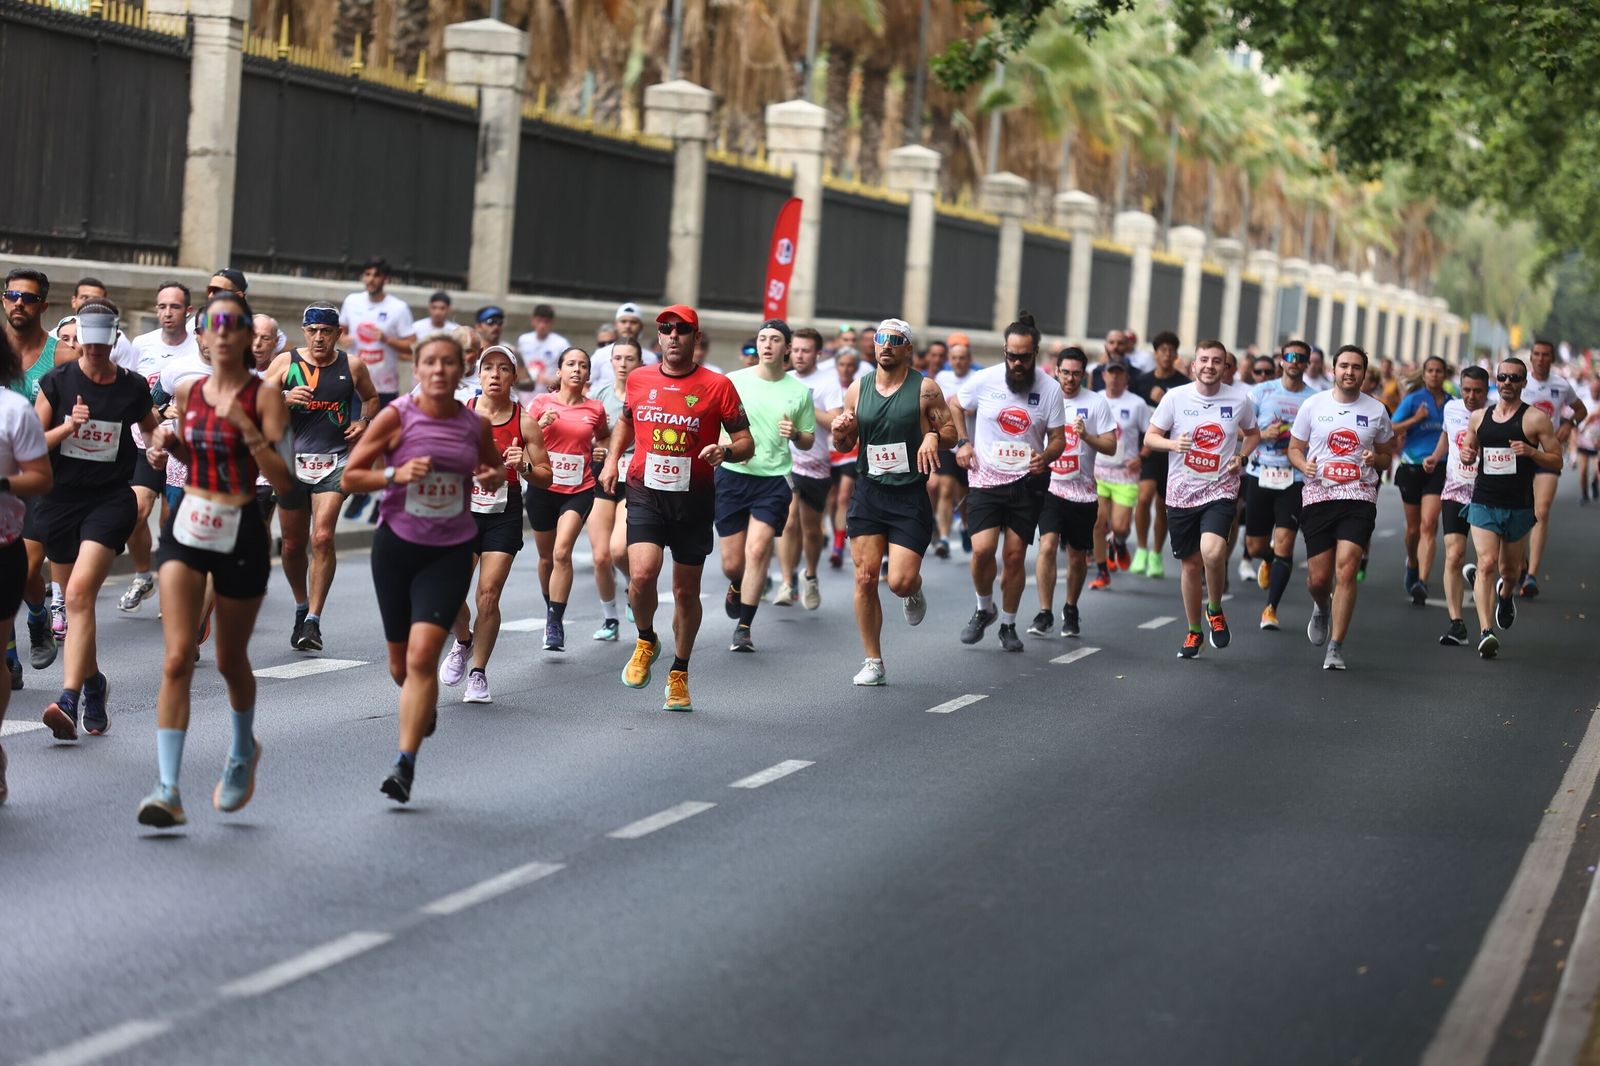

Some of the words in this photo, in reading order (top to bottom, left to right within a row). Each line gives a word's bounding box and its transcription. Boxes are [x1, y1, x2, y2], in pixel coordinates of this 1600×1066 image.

[72, 430, 113, 443] 1257
[653, 443, 686, 453] WOMAN
[998, 448, 1026, 458] 1156
[875, 451, 897, 461] 141
[1188, 455, 1217, 467] 2606
[1487, 454, 1512, 462] 1265
[301, 461, 332, 470] 1354
[550, 460, 578, 472] 1287
[654, 464, 680, 475] 750
[1327, 466, 1357, 477] 2422
[418, 483, 458, 497] 1213
[190, 510, 223, 529] 626
